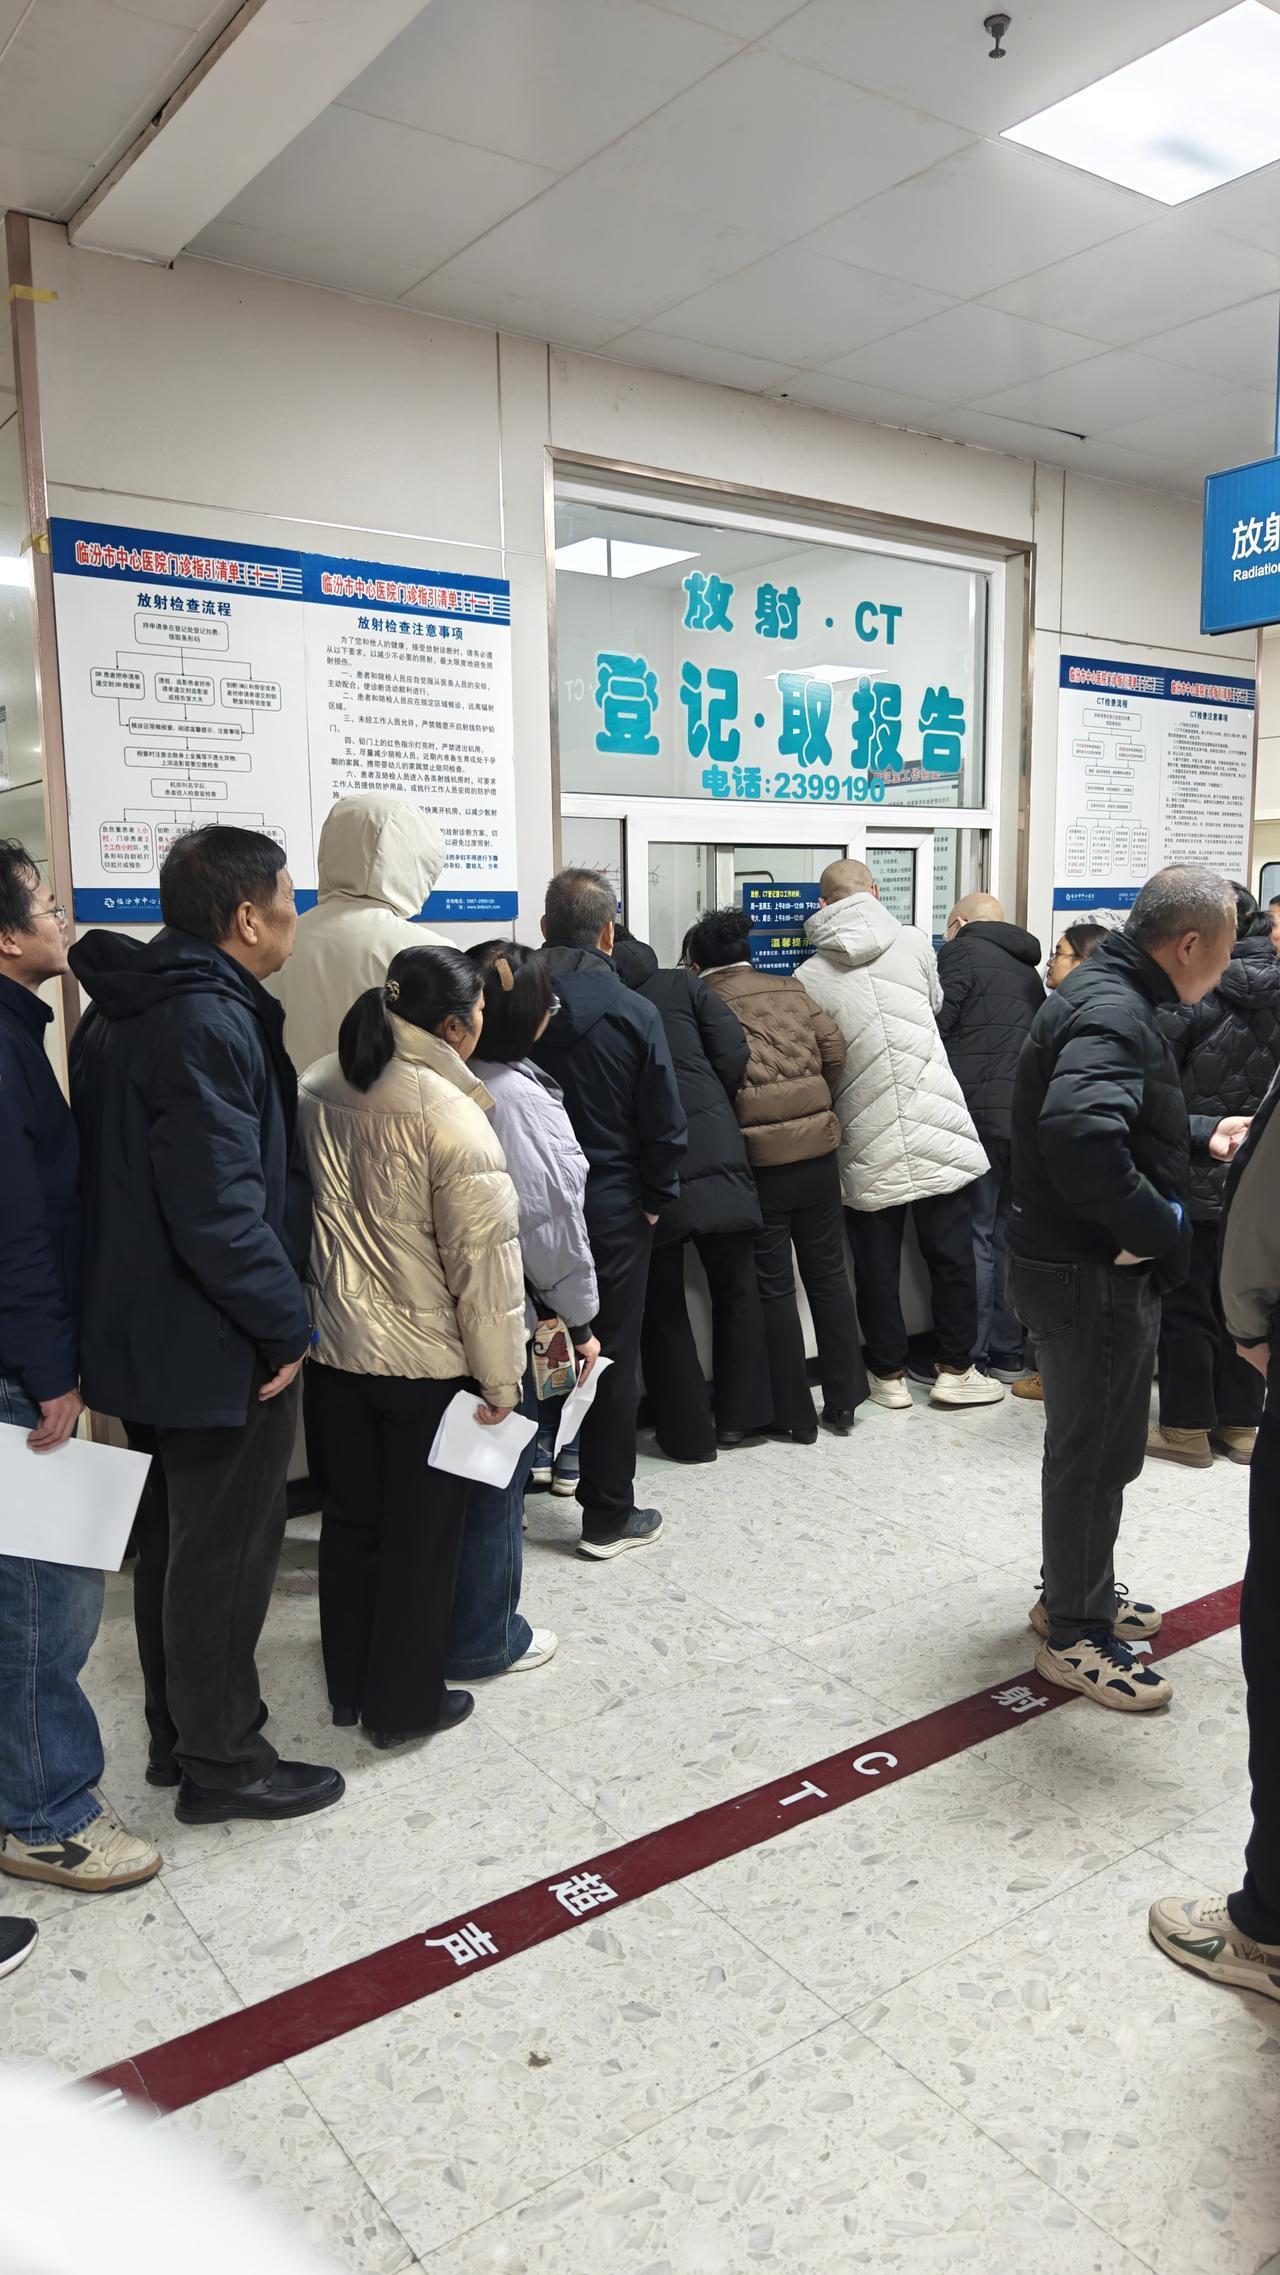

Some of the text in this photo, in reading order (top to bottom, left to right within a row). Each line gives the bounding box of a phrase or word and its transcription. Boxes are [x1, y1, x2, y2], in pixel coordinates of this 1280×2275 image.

[137, 592, 232, 617] 放射检查流程
[357, 616, 464, 640] 放射检查注意事项
[1096, 697, 1129, 708] CT检查流程
[116, 896, 160, 905] 临汾市中心
[990, 1685, 1049, 1713] 射
